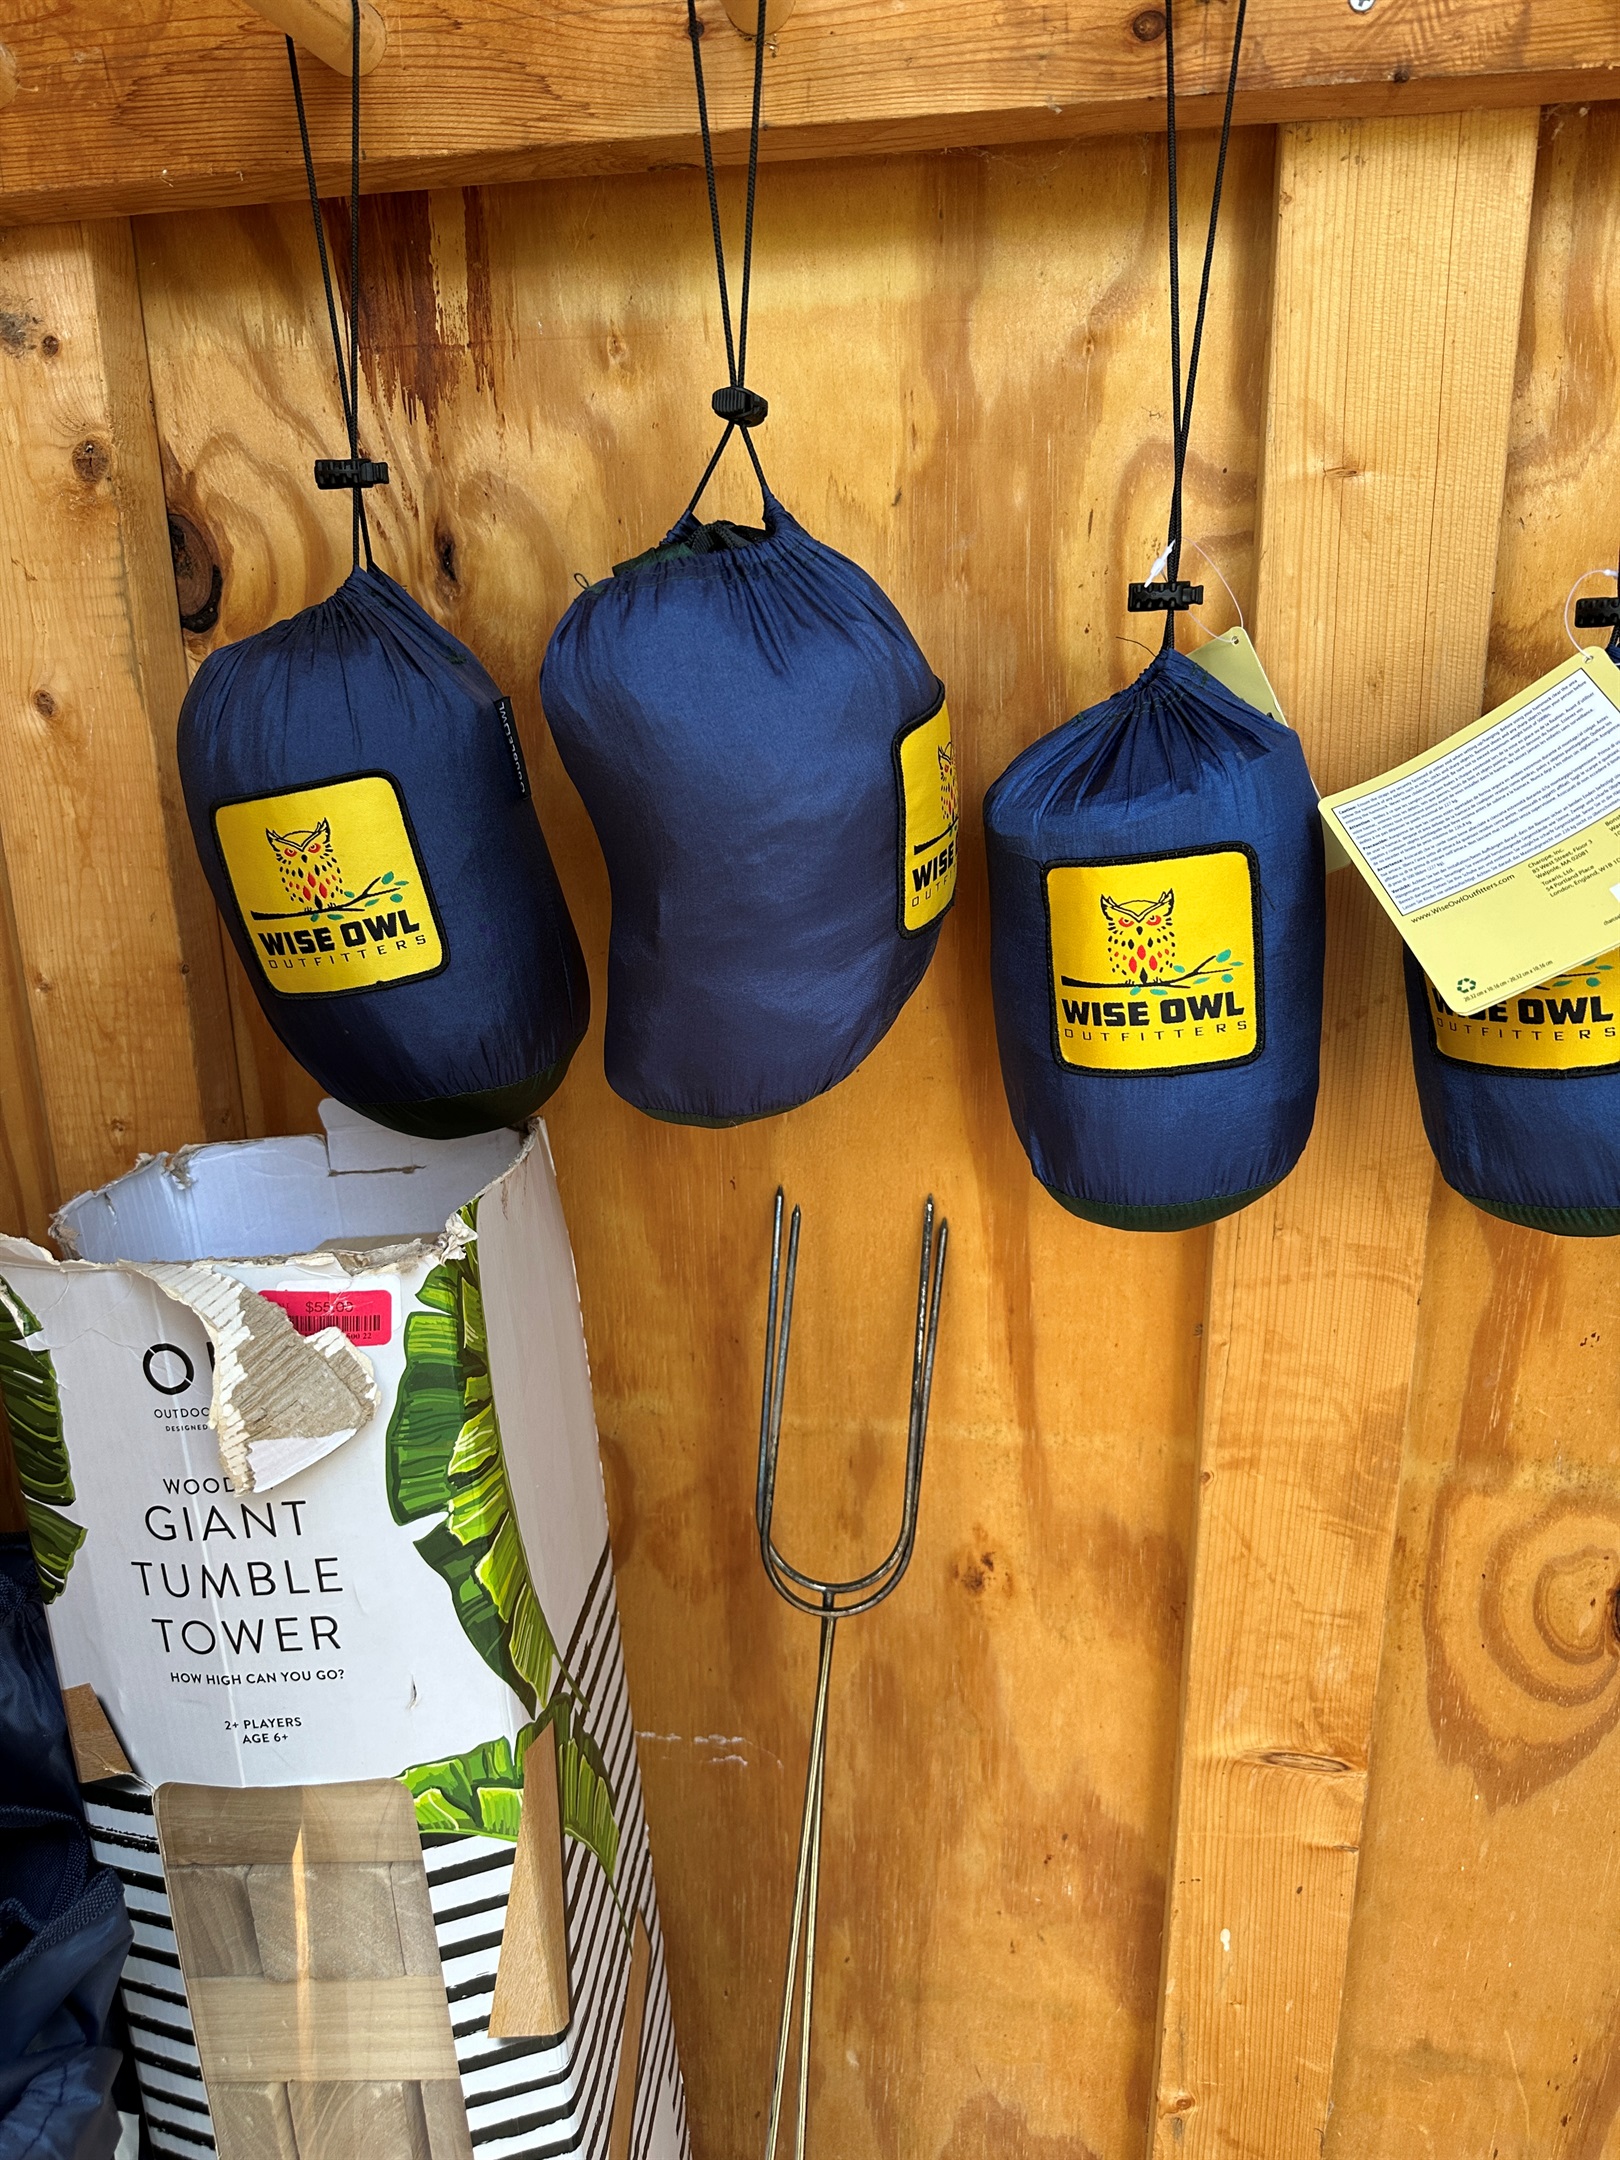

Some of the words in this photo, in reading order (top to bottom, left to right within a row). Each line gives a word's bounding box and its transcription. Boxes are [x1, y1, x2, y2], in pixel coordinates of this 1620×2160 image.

[912, 841, 954, 892] WISE
[1540, 860, 1554, 870] West
[1573, 842, 1588, 852] Floor
[1550, 883, 1574, 897] London,
[1574, 870, 1599, 885] England,
[1554, 873, 1578, 887] Portland
[1579, 864, 1594, 874] Place
[1410, 873, 1515, 923] www.WiseOwlOutfitters.com
[258, 927, 335, 956] WISE
[340, 910, 420, 947] OWL
[268, 934, 426, 969] OUTFITTERS
[1062, 998, 1150, 1027] WISE
[1160, 991, 1245, 1025] OWL
[1518, 996, 1614, 1025] OWL
[1064, 1020, 1247, 1042] OUTFITTERS
[1437, 1017, 1616, 1042] OUTFITTERS
[154, 1407, 209, 1419] OUTDOO
[165, 1424, 208, 1432] DESIGNED
[163, 1476, 236, 1495] WOOD
[145, 1500, 306, 1542] GIANT
[131, 1557, 343, 1599] TUMBLE
[151, 1615, 341, 1655] TOWER
[171, 1672, 202, 1684] HOW
[206, 1674, 242, 1686] HIGH
[246, 1672, 277, 1684] CAN
[280, 1671, 311, 1683] YOU
[316, 1669, 345, 1681] GO?
[224, 1720, 239, 1730] 2+
[243, 1717, 302, 1730] PLAYERS
[242, 1733, 270, 1744] AGE
[274, 1732, 289, 1743] 6+
